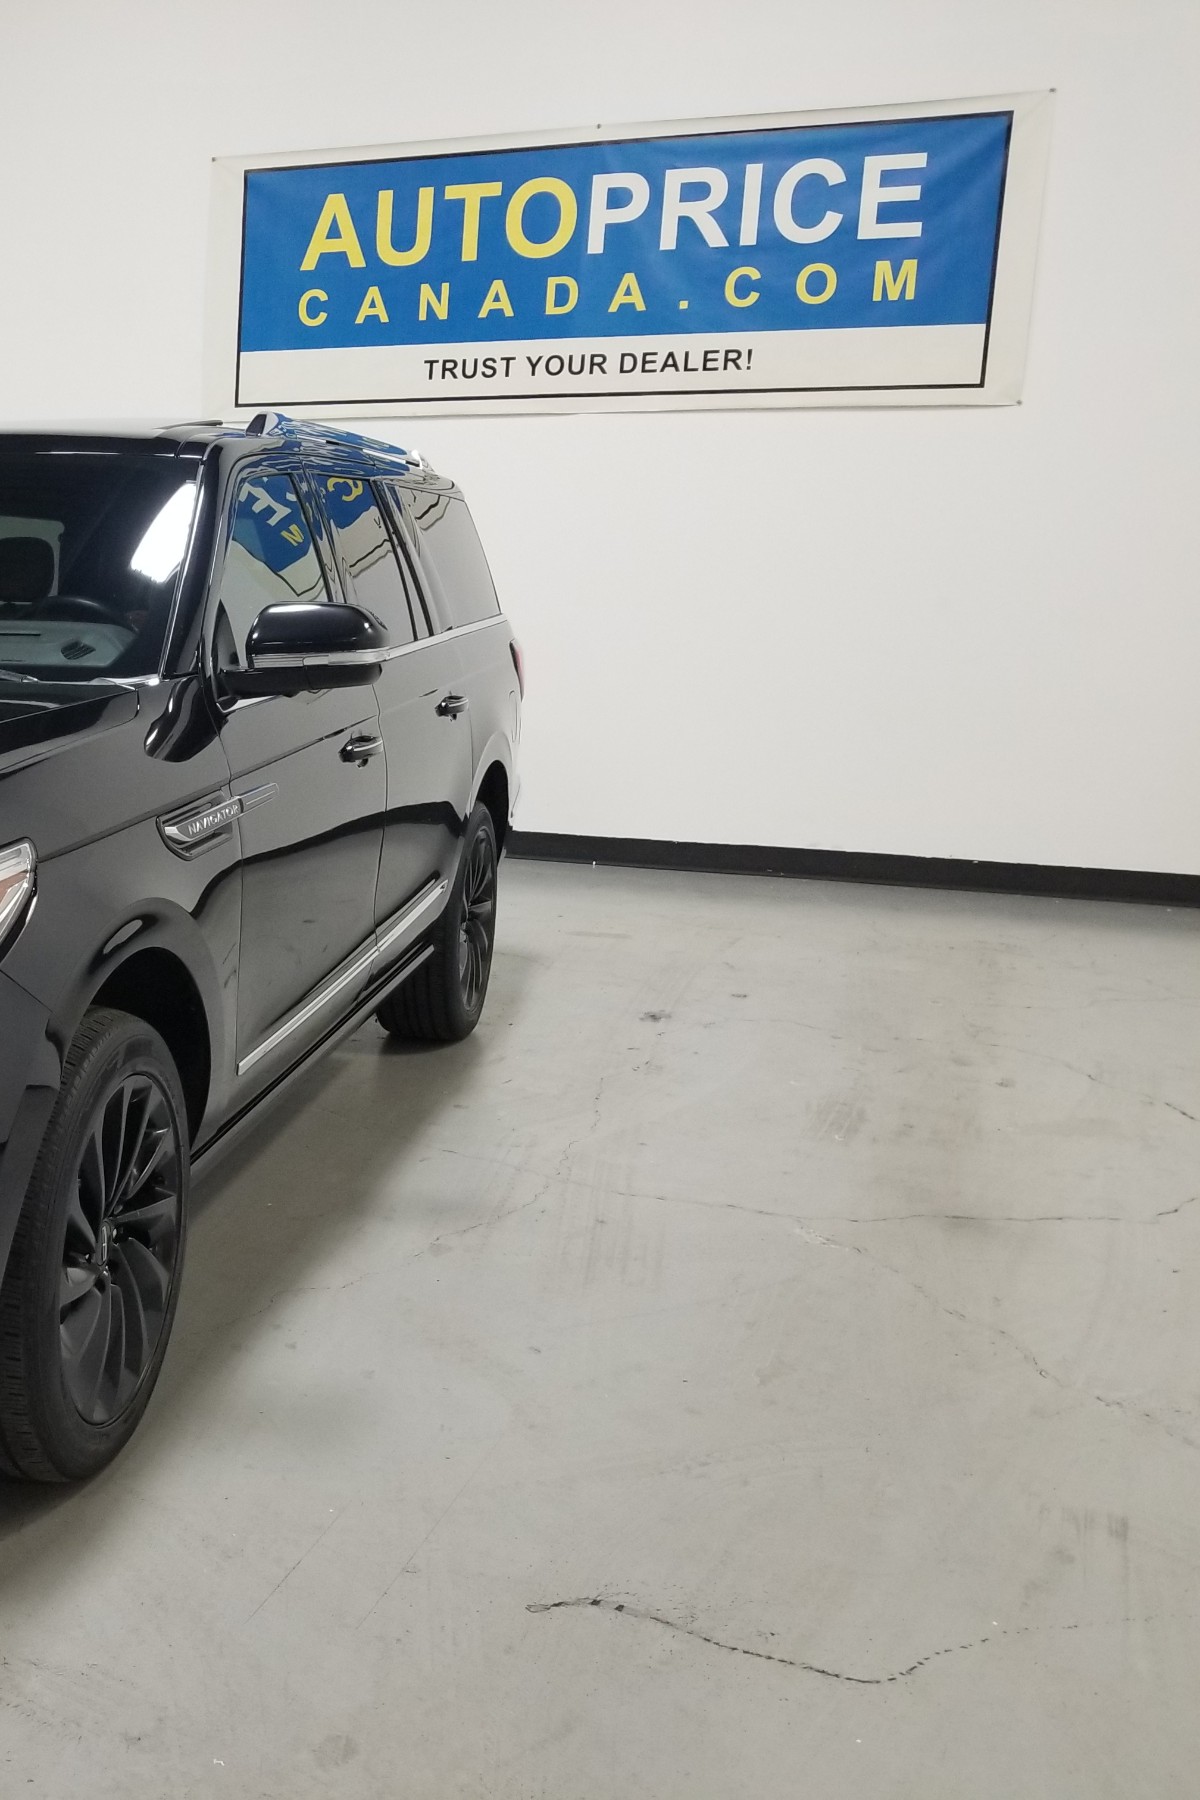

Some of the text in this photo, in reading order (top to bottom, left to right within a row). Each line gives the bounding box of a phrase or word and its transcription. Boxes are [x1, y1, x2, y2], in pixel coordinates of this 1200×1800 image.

[299, 152, 928, 271] AUTOPRICE
[298, 258, 918, 327] CANADA.COM
[423, 348, 753, 380] TRUST YOUR DEALER!
[187, 803, 239, 836] NAVIGATOR
